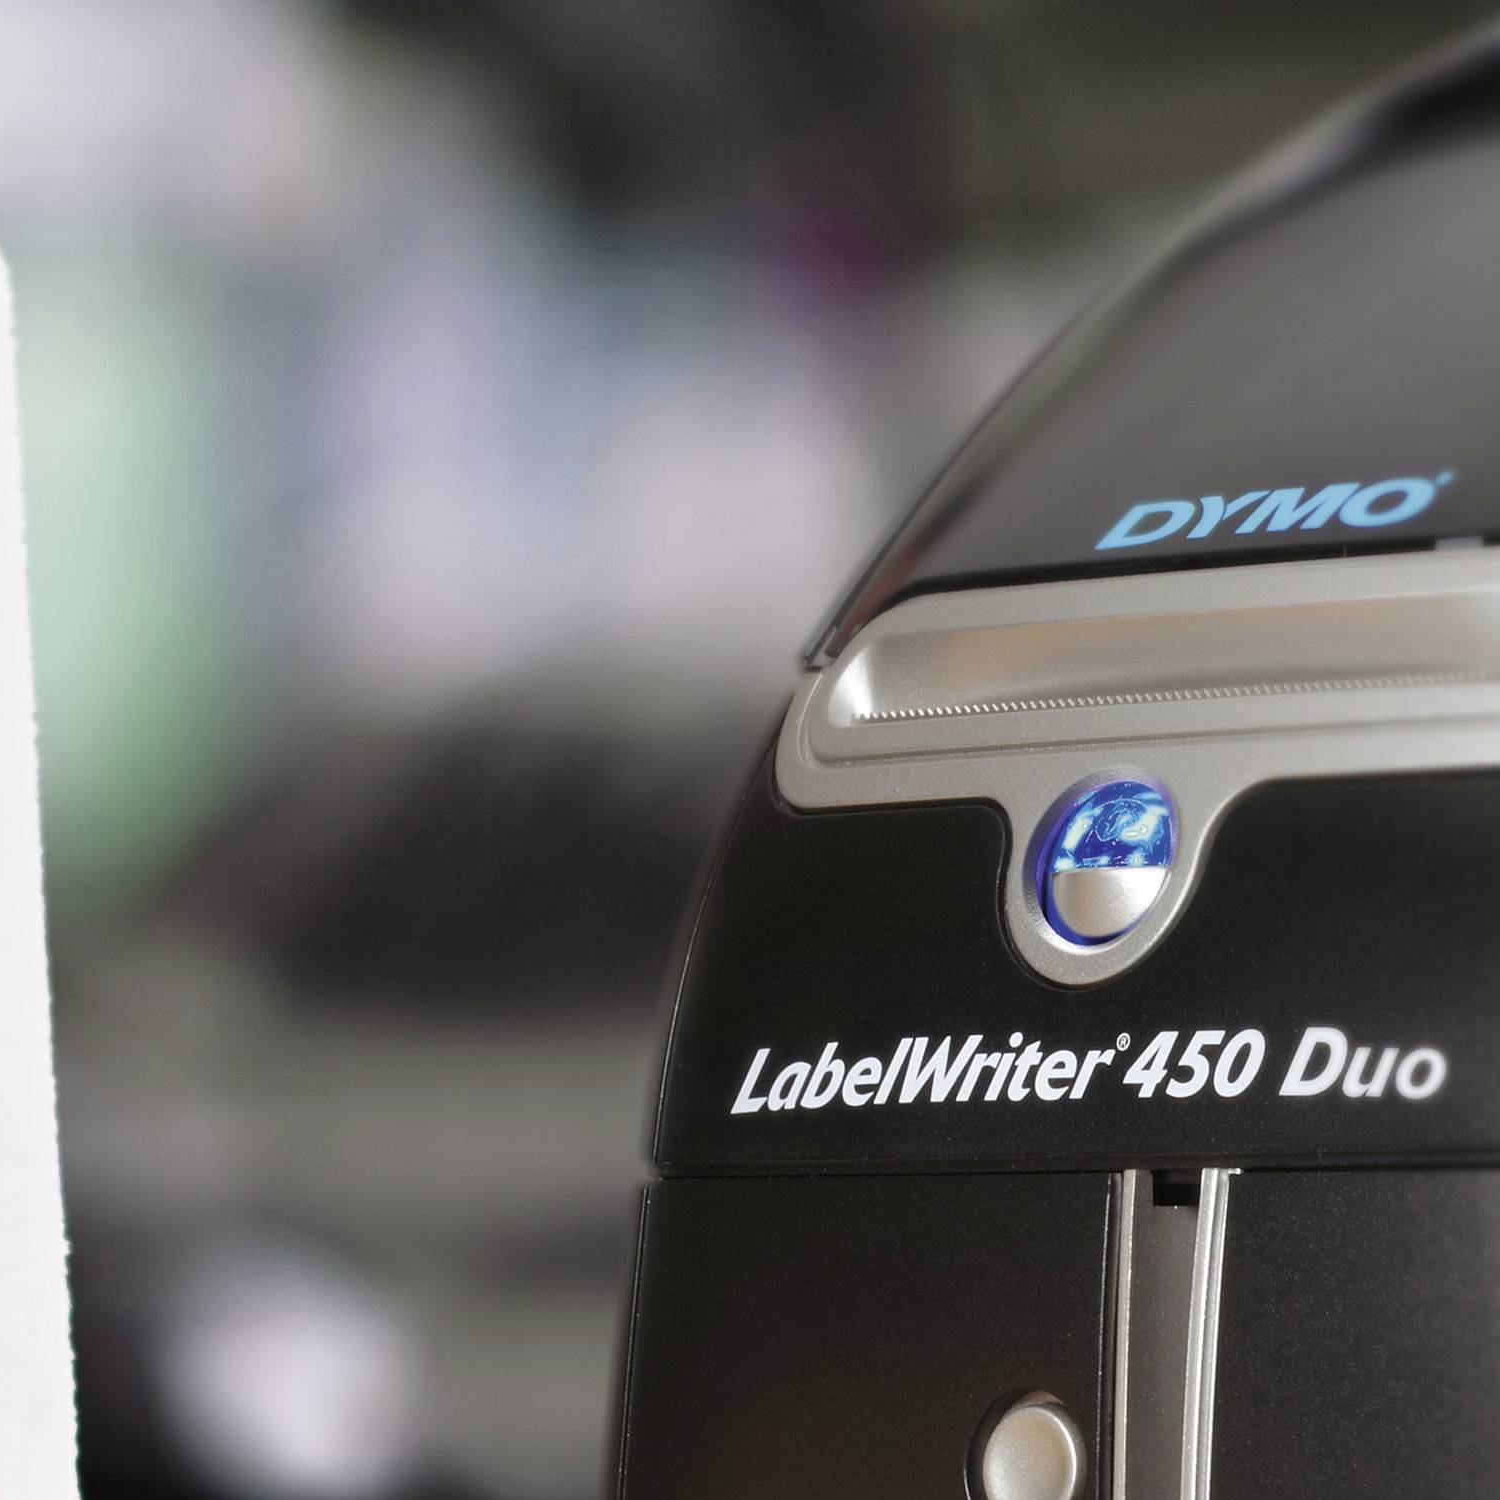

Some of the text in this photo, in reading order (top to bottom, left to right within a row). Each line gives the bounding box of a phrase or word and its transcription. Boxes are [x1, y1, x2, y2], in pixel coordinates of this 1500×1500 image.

[1095, 476, 1438, 550] DYMO
[1122, 1028, 1267, 1098] 450
[1279, 1026, 1448, 1100] Duo
